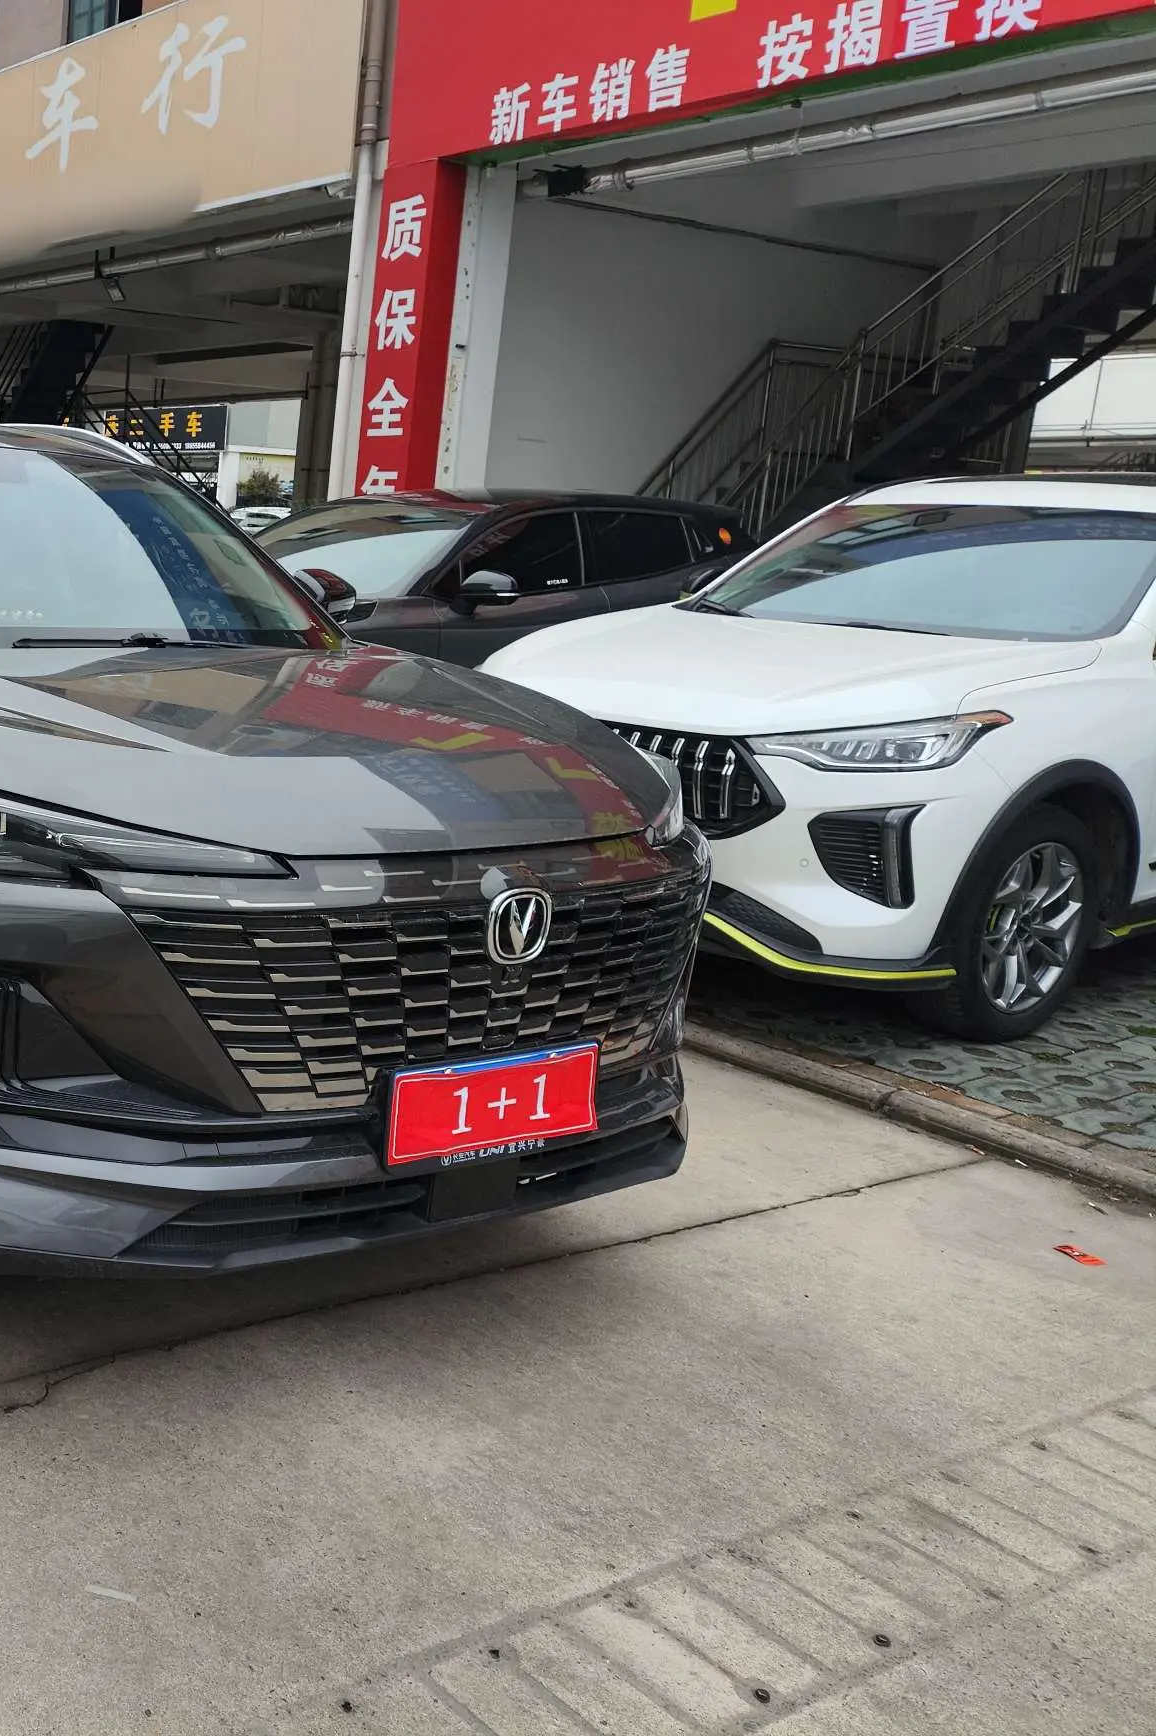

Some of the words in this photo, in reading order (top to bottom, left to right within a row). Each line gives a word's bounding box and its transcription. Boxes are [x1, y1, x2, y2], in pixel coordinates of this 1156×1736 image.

[757, 0, 1042, 88] 按揭置换
[488, 43, 691, 146] 新车销售
